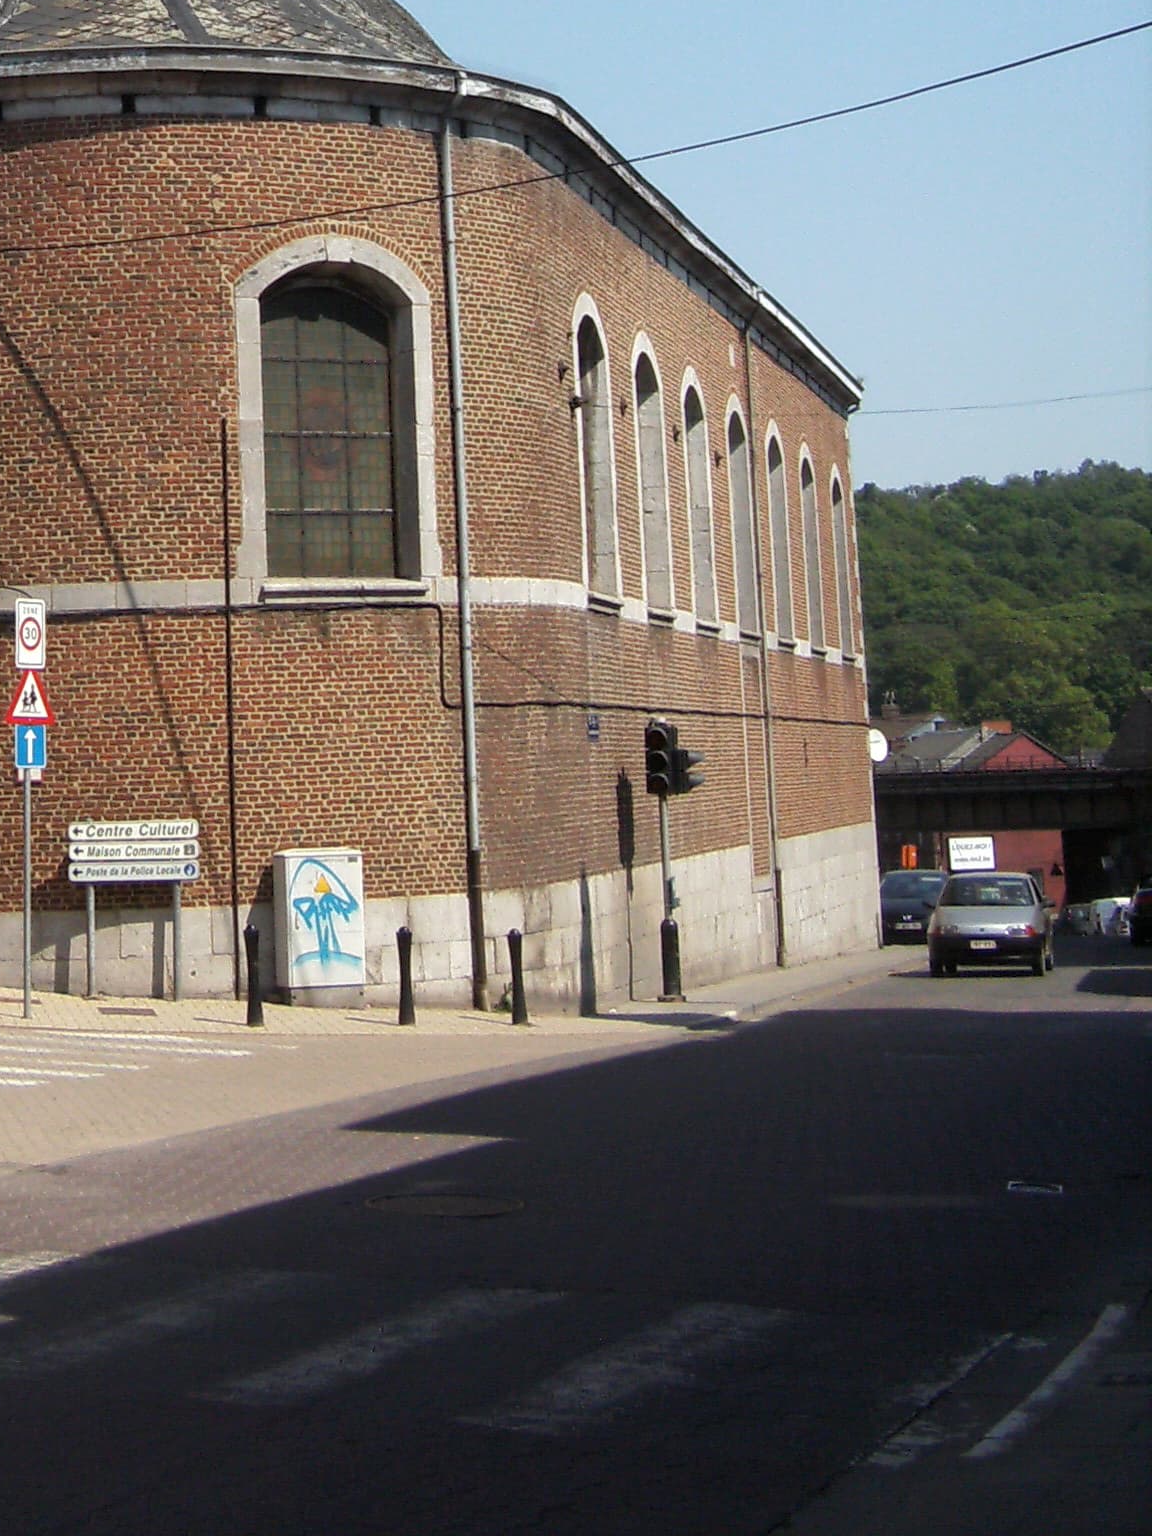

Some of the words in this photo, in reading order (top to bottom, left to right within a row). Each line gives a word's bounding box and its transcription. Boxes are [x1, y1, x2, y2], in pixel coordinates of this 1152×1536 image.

[24, 627, 37, 640] 30
[85, 824, 133, 838] Centre
[139, 823, 194, 837] Culturel
[87, 846, 122, 857] Maison
[124, 845, 181, 857] Communale
[85, 867, 108, 877] Poste
[109, 866, 119, 876] de
[121, 866, 128, 876] la
[130, 866, 154, 876] Police
[156, 865, 181, 876] Locale
